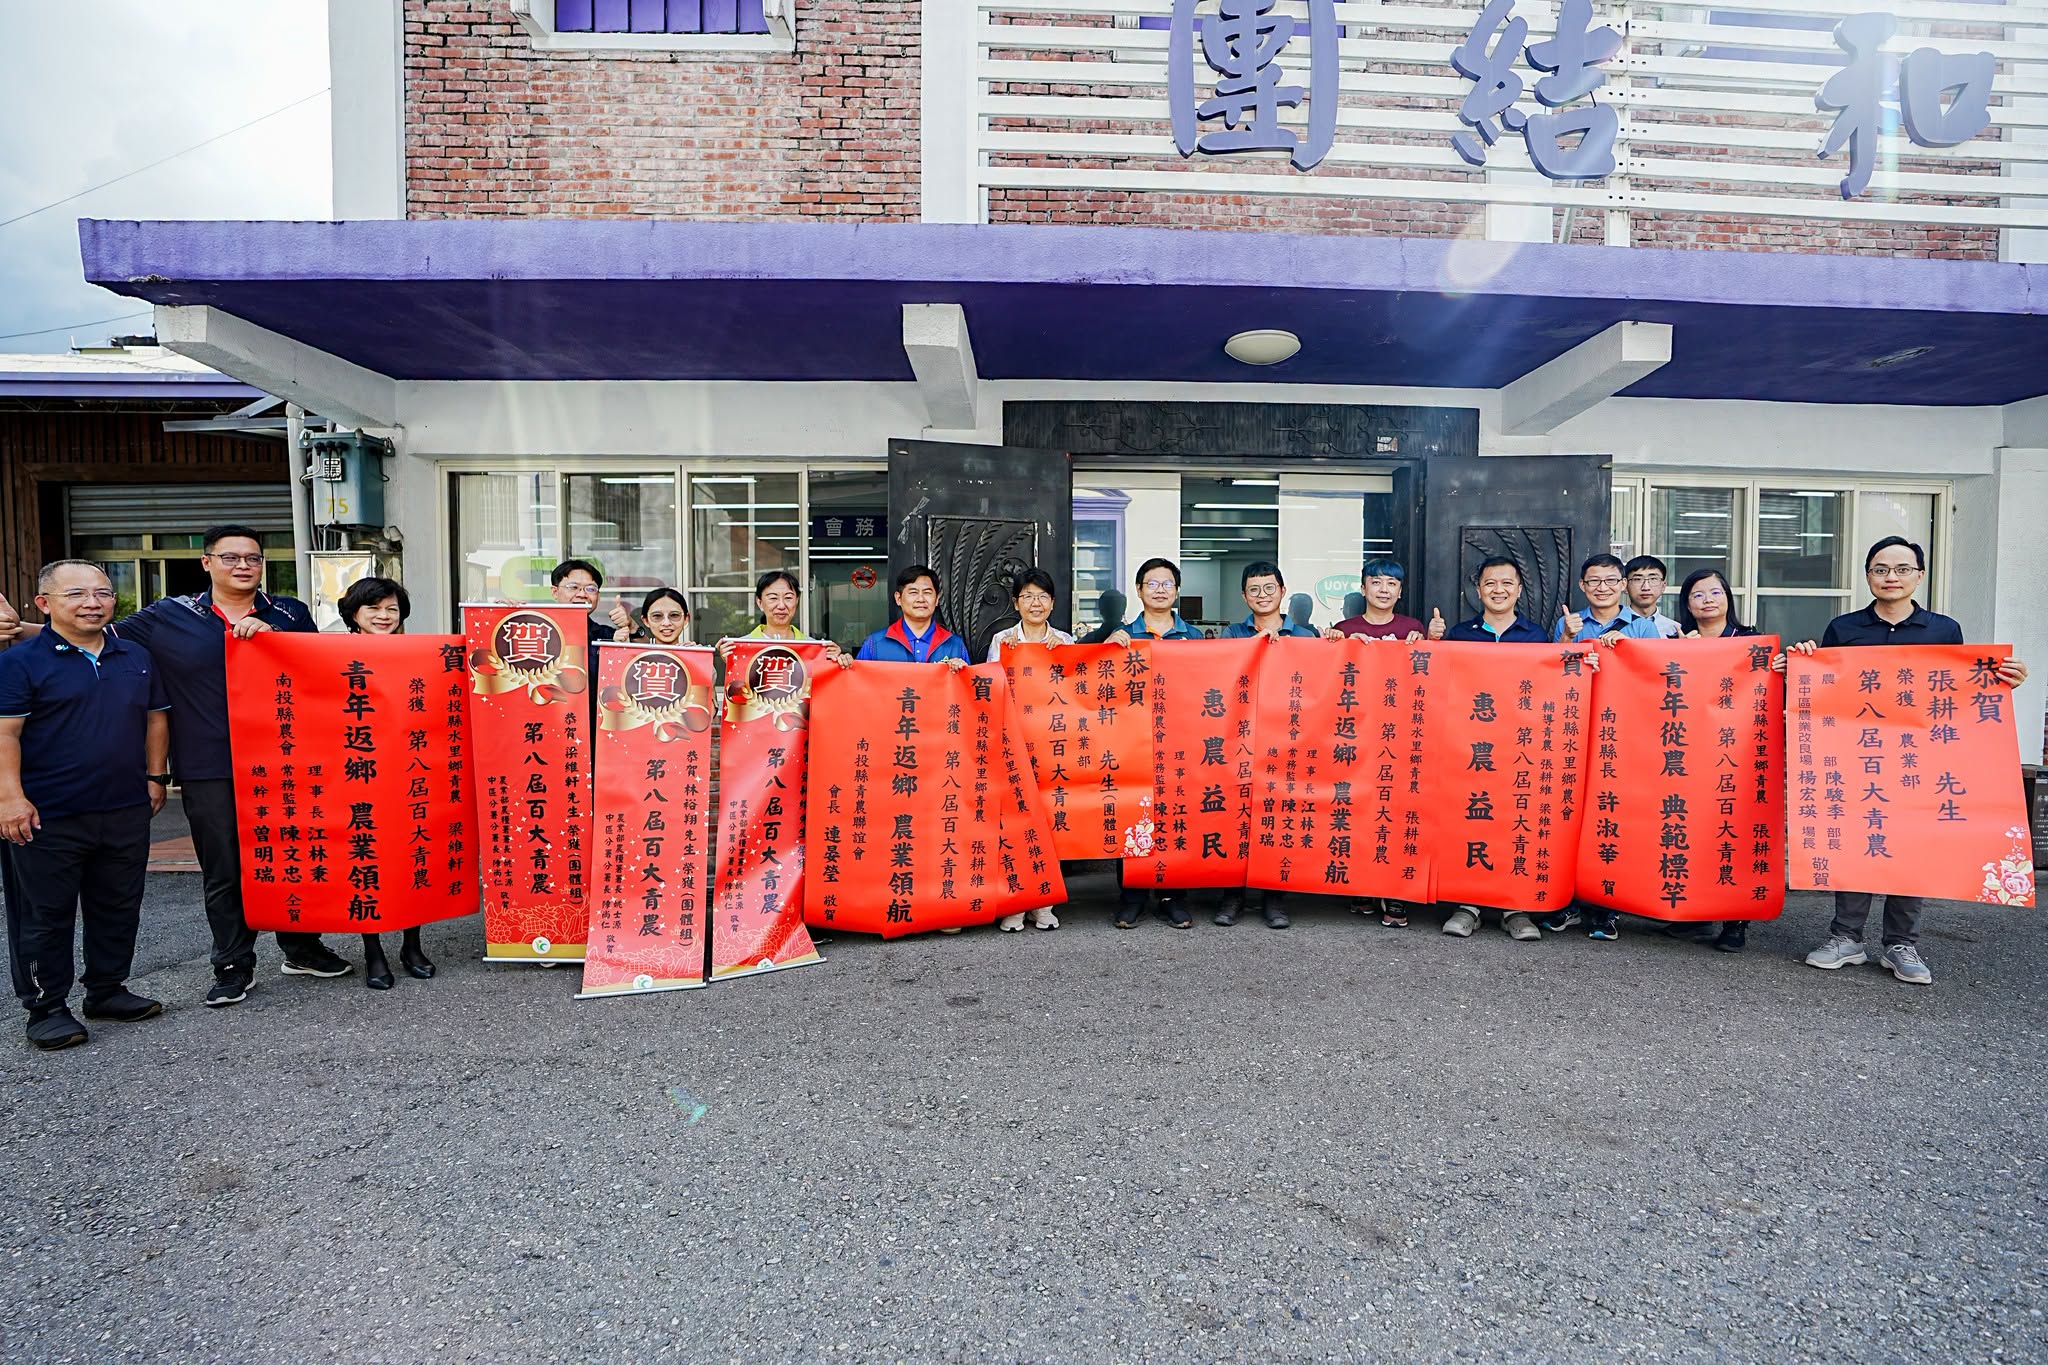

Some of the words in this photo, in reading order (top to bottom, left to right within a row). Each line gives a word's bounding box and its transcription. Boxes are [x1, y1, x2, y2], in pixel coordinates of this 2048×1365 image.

[825, 517, 874, 537] 會務
[440, 644, 466, 674] 賀
[502, 621, 553, 663] 賀
[1409, 649, 1432, 676] 賀
[1560, 650, 1584, 677] 賀
[1747, 644, 1773, 673] 賀
[408, 678, 427, 713] 榮獲
[633, 661, 681, 702] 賀
[753, 656, 798, 693] 賀
[971, 675, 993, 702] 賀
[1074, 662, 1089, 695] 榮獲
[1097, 659, 1119, 726] 梁維軒
[1122, 650, 1150, 708] 恭賀
[1238, 675, 1250, 704] 榮獲
[1383, 678, 1397, 708] 榮獲
[1518, 679, 1533, 711] 榮獲
[1718, 677, 1735, 710] 榮獲
[1896, 668, 1916, 708] 榮獲
[1966, 656, 2004, 724] 恭賀
[275, 672, 297, 756] 南投縣農會
[340, 660, 378, 784] 青年返鄉
[565, 712, 578, 740] 恭賀
[946, 703, 962, 735] 榮獲
[1152, 673, 1167, 743] 南投縣農會
[1288, 671, 1303, 740] 南投縣農會
[1333, 661, 1360, 767] 青年返鄉
[1540, 701, 1555, 751] 輔導青農
[1659, 661, 1689, 777] 青年從農
[1798, 674, 1813, 766] 臺中區農業改良場
[1821, 673, 1837, 767] 農業部
[1926, 669, 1961, 745] 張耕維
[446, 684, 464, 804] 南投縣水里鄉青農
[686, 750, 698, 777] 恭賀
[891, 687, 922, 799] 青年返鄉
[1048, 663, 1071, 832] 第八屆百大青農
[1077, 717, 1091, 769] 農業部
[1408, 685, 1426, 794] 南投縣水里鄉青農
[1561, 687, 1579, 821] 南投縣水里鄉農會
[1598, 706, 1618, 779] 南投縣長
[1752, 683, 1769, 804] 南投縣水里鄉青農
[1855, 669, 1893, 859] 第八屆百大青農
[1899, 732, 1921, 790] 農業部
[251, 765, 268, 819] 總幹事
[280, 764, 297, 819] 常務監事
[307, 765, 325, 819] 理事長
[974, 711, 989, 823] 南投縣水里鄉青農
[1155, 751, 1166, 797] 常務監事
[1174, 751, 1185, 797] 理事長
[1200, 688, 1228, 860] 惠農益民
[1235, 719, 1254, 861] 第八屆百大青農
[1266, 747, 1278, 794] 總幹事
[1285, 747, 1298, 794] 常務監事
[1304, 749, 1317, 794] 理事長
[1464, 691, 1497, 871] 惠農益民
[1540, 758, 1553, 796] 張耕維
[406, 729, 433, 890] 第八屆百大青農
[523, 722, 555, 896] 第八屆百大青農
[827, 784, 842, 814] 會長
[851, 737, 870, 861] 南投縣青農聯誼會
[1372, 722, 1397, 864] 第八屆百大青農
[1510, 726, 1534, 877] 第八屆百大青農
[1715, 727, 1738, 886] 第八屆百大青農
[1797, 770, 1817, 819] 楊宏瑛
[1824, 770, 1846, 820] 陳駿季
[1934, 771, 1967, 822] 先生
[683, 784, 699, 856] 林裕翔先生
[760, 748, 787, 914] 第八屆百大青農
[939, 750, 962, 900] 第八屆百大青農
[1153, 803, 1168, 851] 陳文忠
[1172, 803, 1188, 850] 江林秉
[1259, 798, 1275, 848] 曾明瑞
[1278, 799, 1297, 849] 陳文忠
[1300, 800, 1316, 849] 江林秉
[1324, 781, 1353, 885] 農業領航
[1403, 810, 1420, 856] 張耕維
[1537, 803, 1551, 840] 梁維軒
[1596, 791, 1621, 865] 許淑華
[1801, 826, 1816, 850] 場長
[1827, 827, 1842, 850] 部長
[253, 826, 275, 883] 曾明瑞
[280, 826, 303, 883] 陳文忠
[307, 826, 329, 883] 江林秉
[346, 802, 381, 922] 農業領航
[447, 822, 464, 872] 梁維軒
[638, 759, 669, 937] 第八屆百大青農
[886, 814, 915, 923] 農業領航
[970, 840, 987, 888] 張耕維
[1024, 829, 1047, 875] 梁維軒
[1038, 881, 1052, 896] 君
[1535, 848, 1550, 883] 林裕翔
[1658, 794, 1690, 909] 典範標竿
[1751, 823, 1770, 875] 張耕維
[1812, 857, 1830, 887] 敬賀
[447, 881, 464, 896] 君
[1402, 866, 1417, 880] 君
[1534, 890, 1547, 902] 君
[1601, 879, 1616, 896] 賀
[1751, 885, 1769, 900] 君
[823, 895, 838, 921] 敬賀
[969, 898, 984, 912] 君
